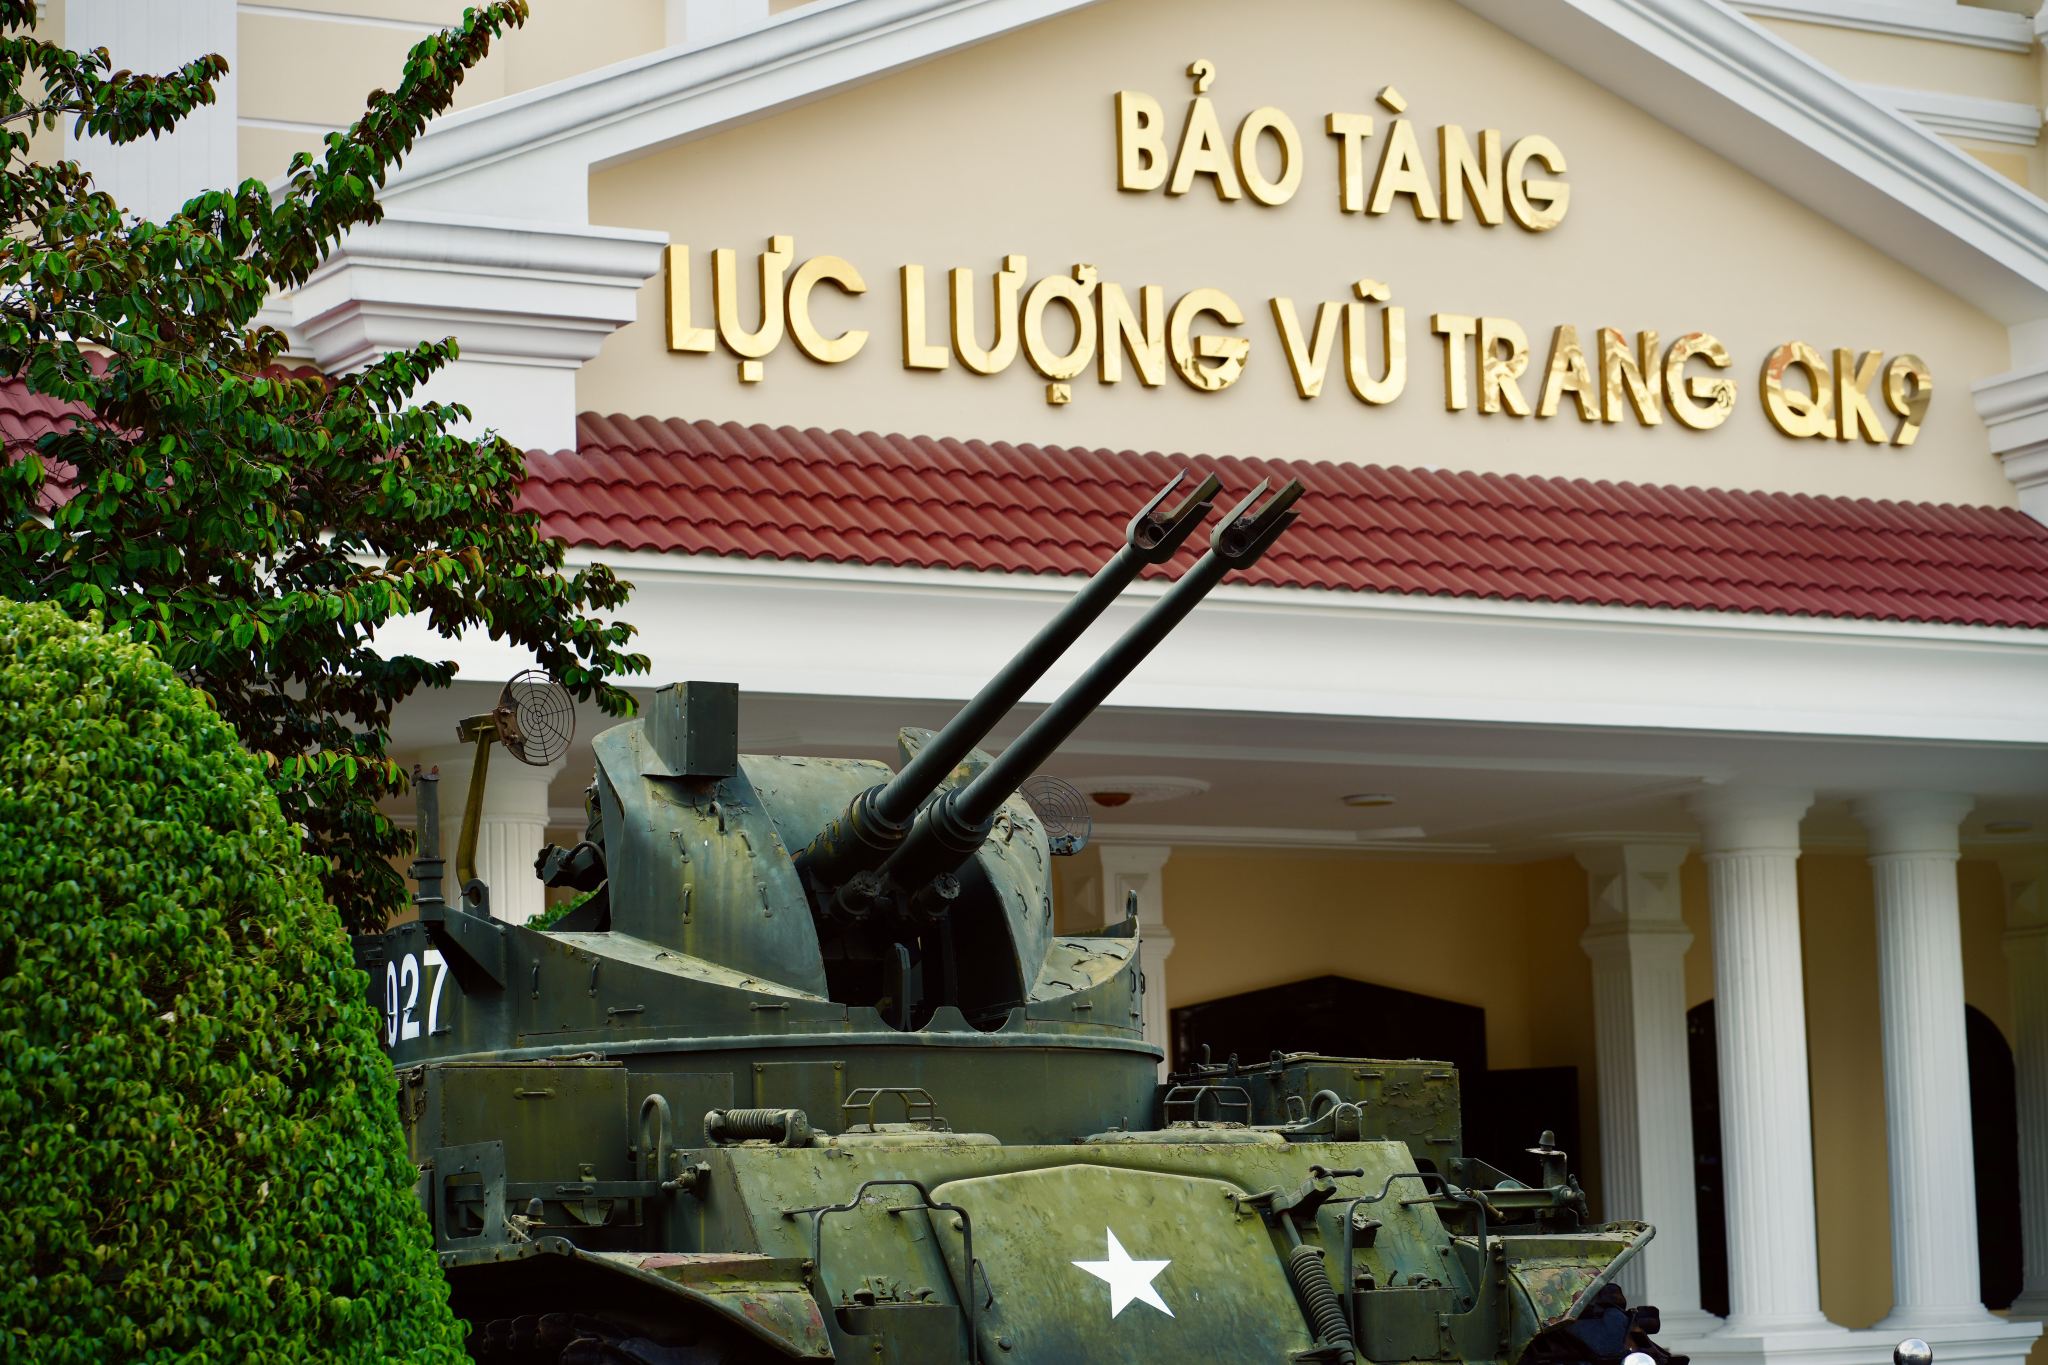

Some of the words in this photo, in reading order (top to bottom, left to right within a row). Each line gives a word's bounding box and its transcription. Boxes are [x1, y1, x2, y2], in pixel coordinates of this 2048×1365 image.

[1115, 59, 1303, 206] BẢO
[1326, 85, 1570, 232] TÀNG
[664, 234, 869, 383] LỰC
[899, 254, 1251, 405] LƯỢNG
[1270, 278, 1405, 406] VŨ
[1431, 312, 1738, 431] TRANG
[1760, 340, 1933, 447] QK9
[386, 949, 449, 1048] 027
